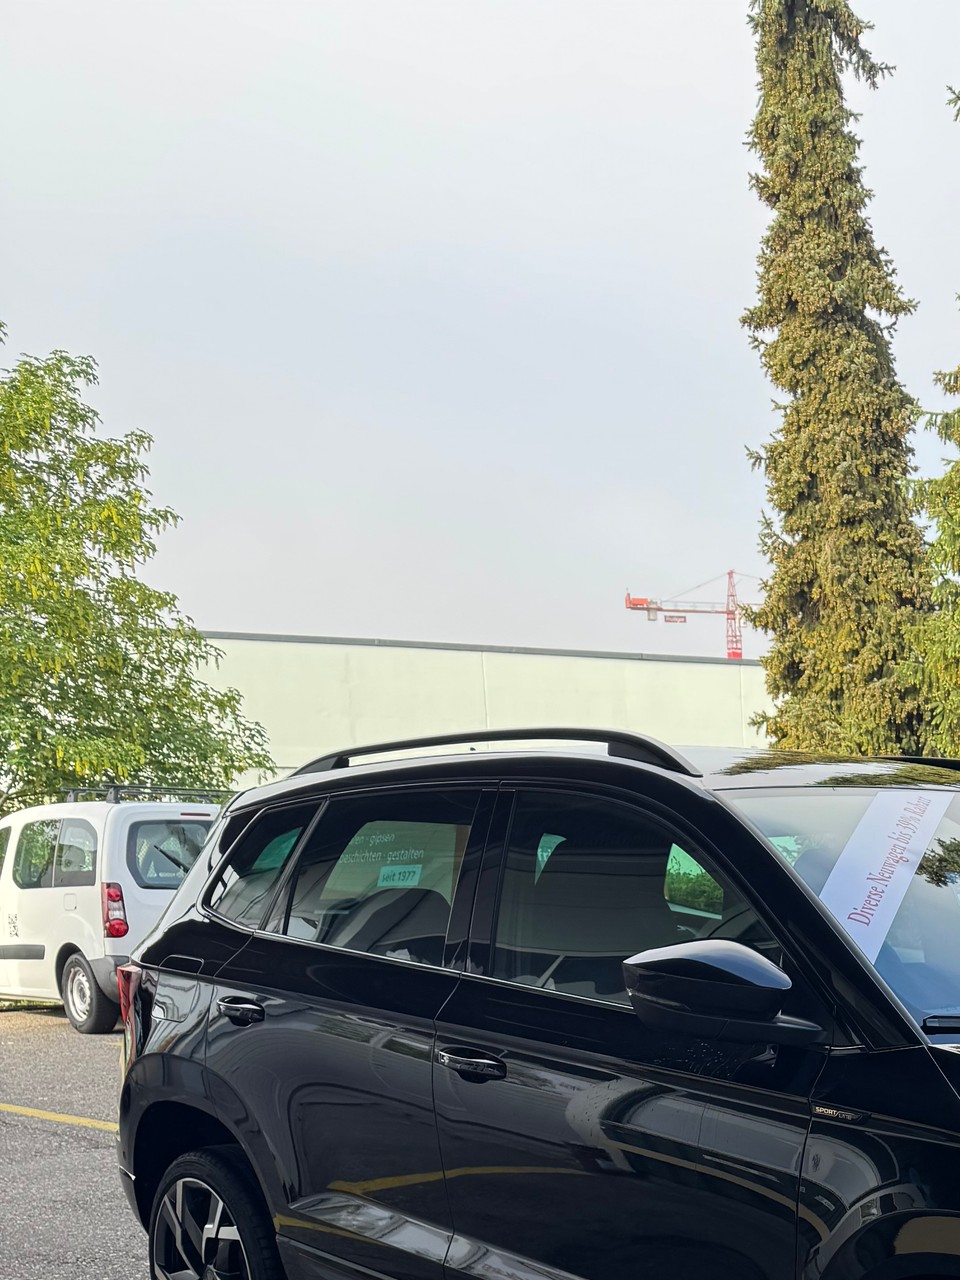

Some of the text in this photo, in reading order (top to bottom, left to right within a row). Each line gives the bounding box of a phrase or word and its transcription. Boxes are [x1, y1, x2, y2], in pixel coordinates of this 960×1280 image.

[386, 847, 425, 863] gestalten
[382, 870, 416, 882] seit 1977
[847, 886, 885, 927] Diverse
[866, 843, 909, 887] Neuwagen
[888, 831, 912, 844] bis
